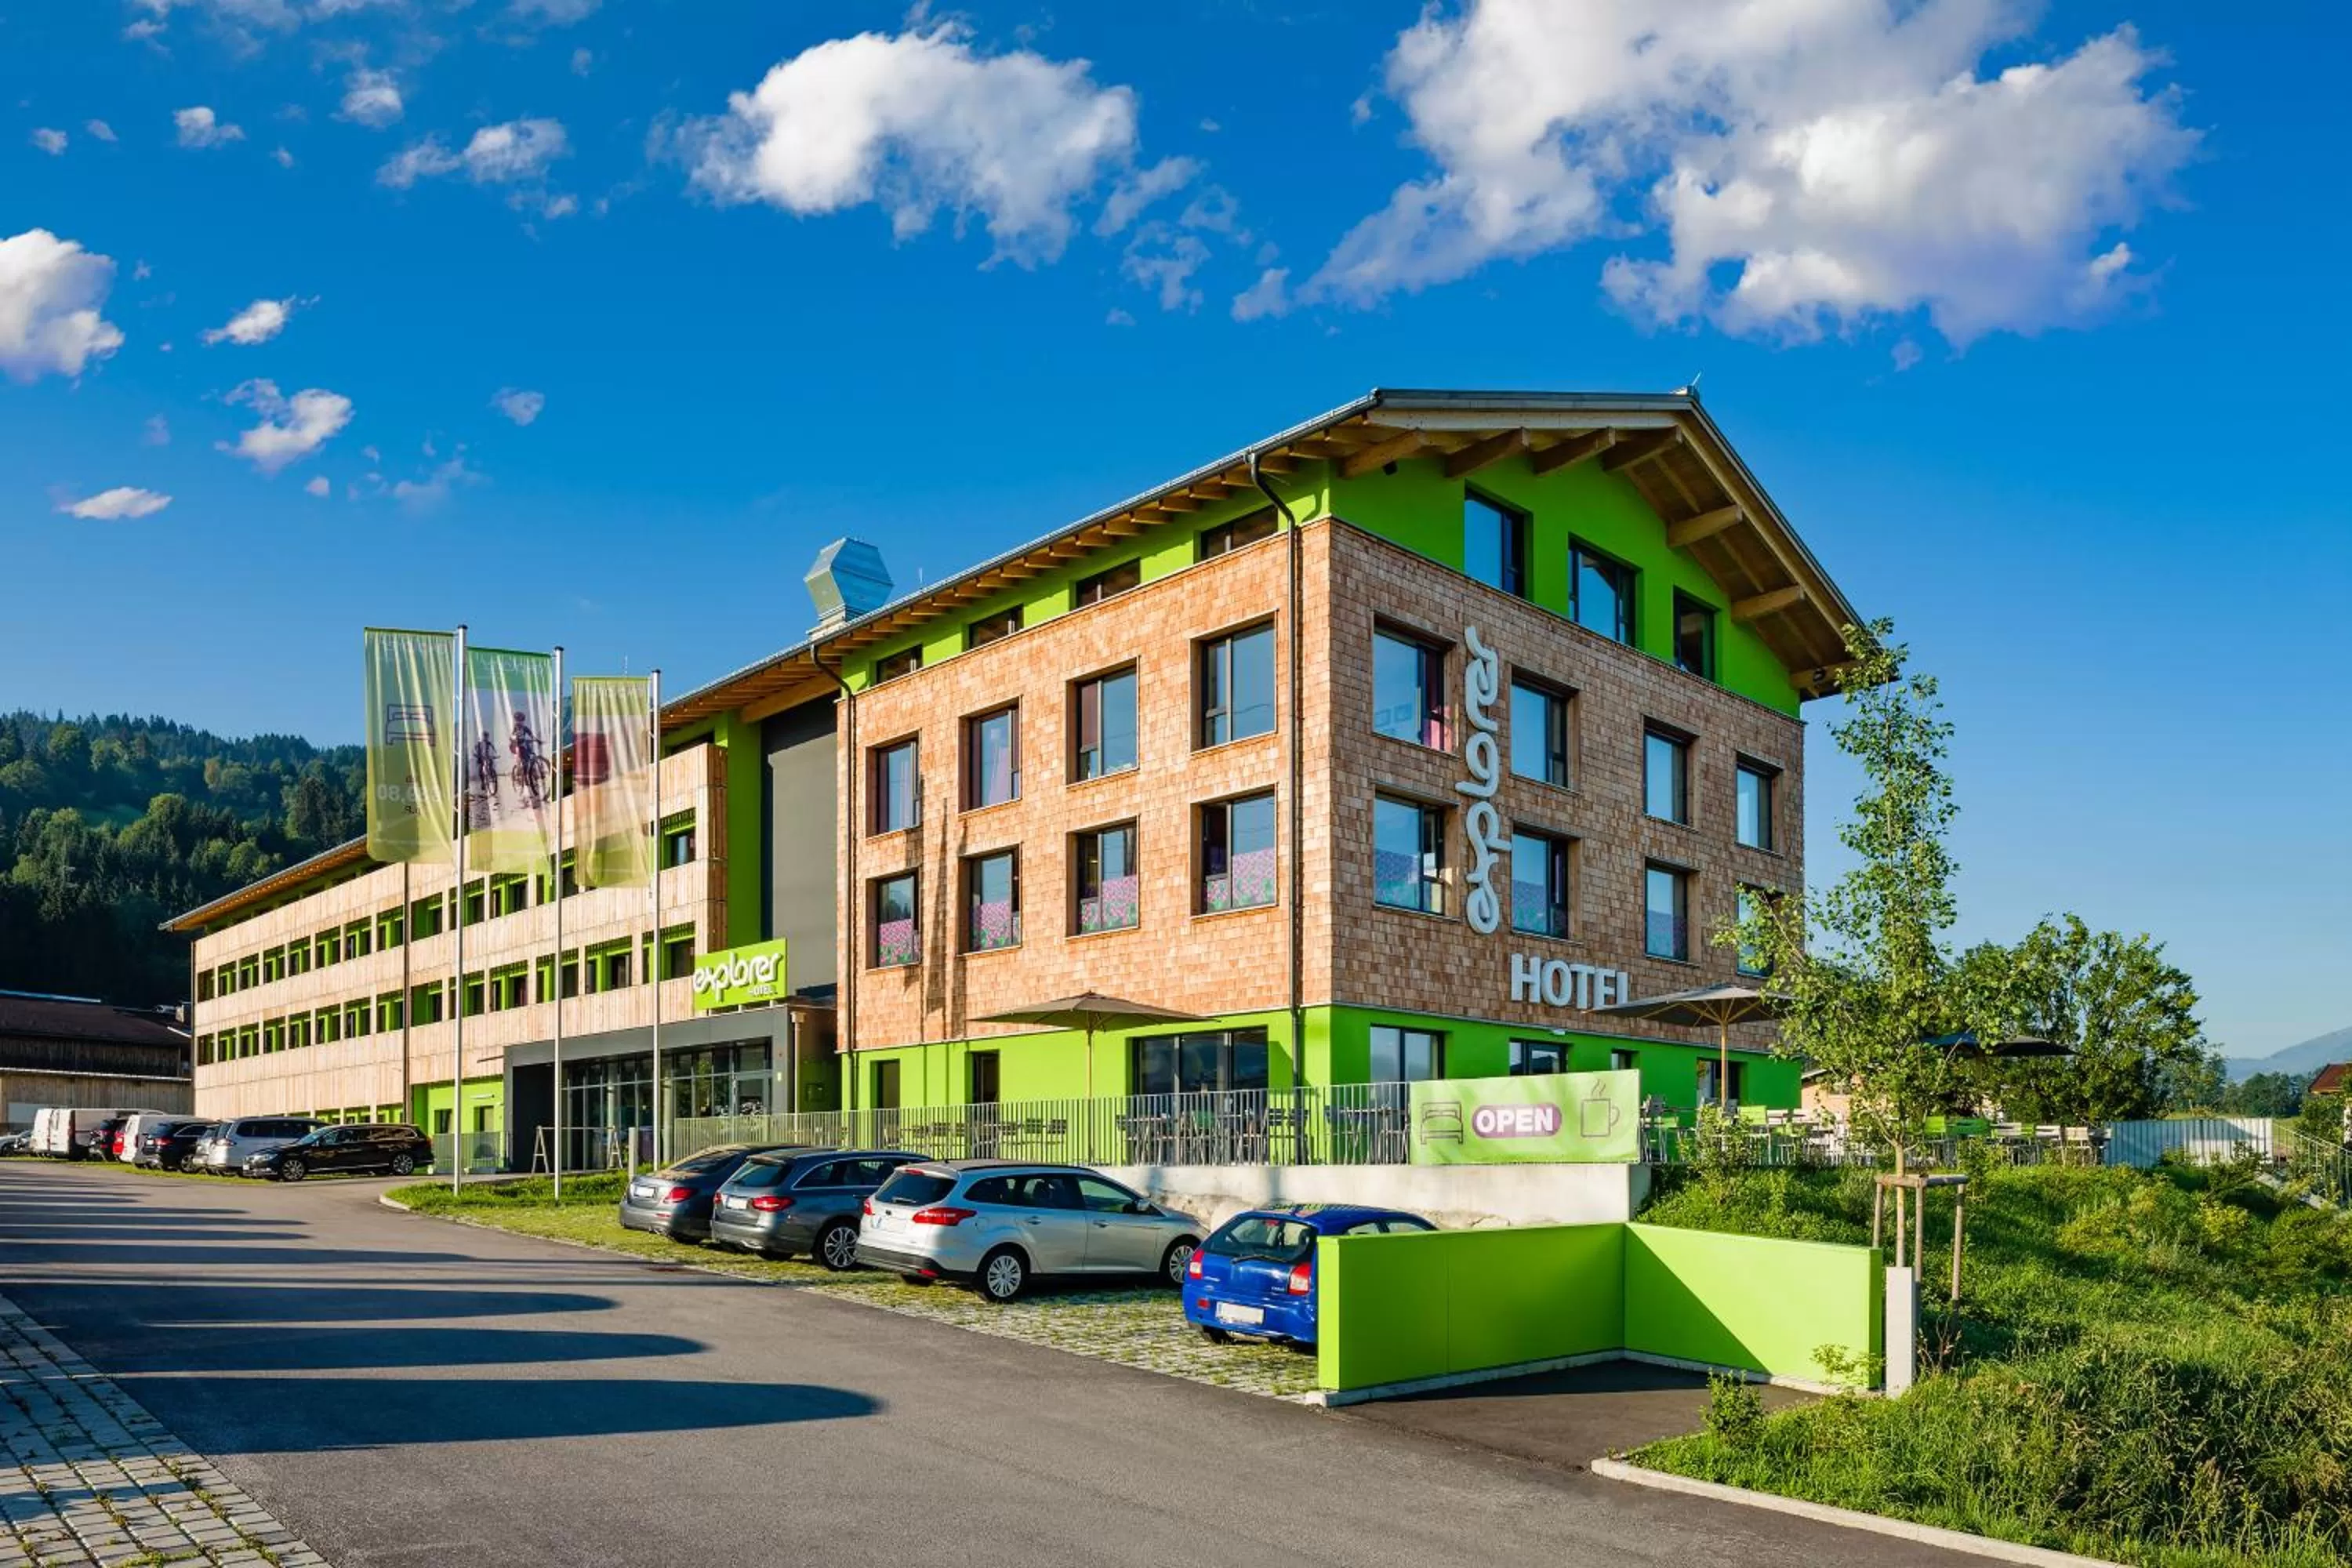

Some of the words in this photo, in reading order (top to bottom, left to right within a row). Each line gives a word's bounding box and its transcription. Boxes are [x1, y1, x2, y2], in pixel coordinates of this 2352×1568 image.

[1455, 626, 1512, 934] explorer
[692, 952, 782, 1003] explorer
[1475, 1107, 1553, 1133] OPEN
